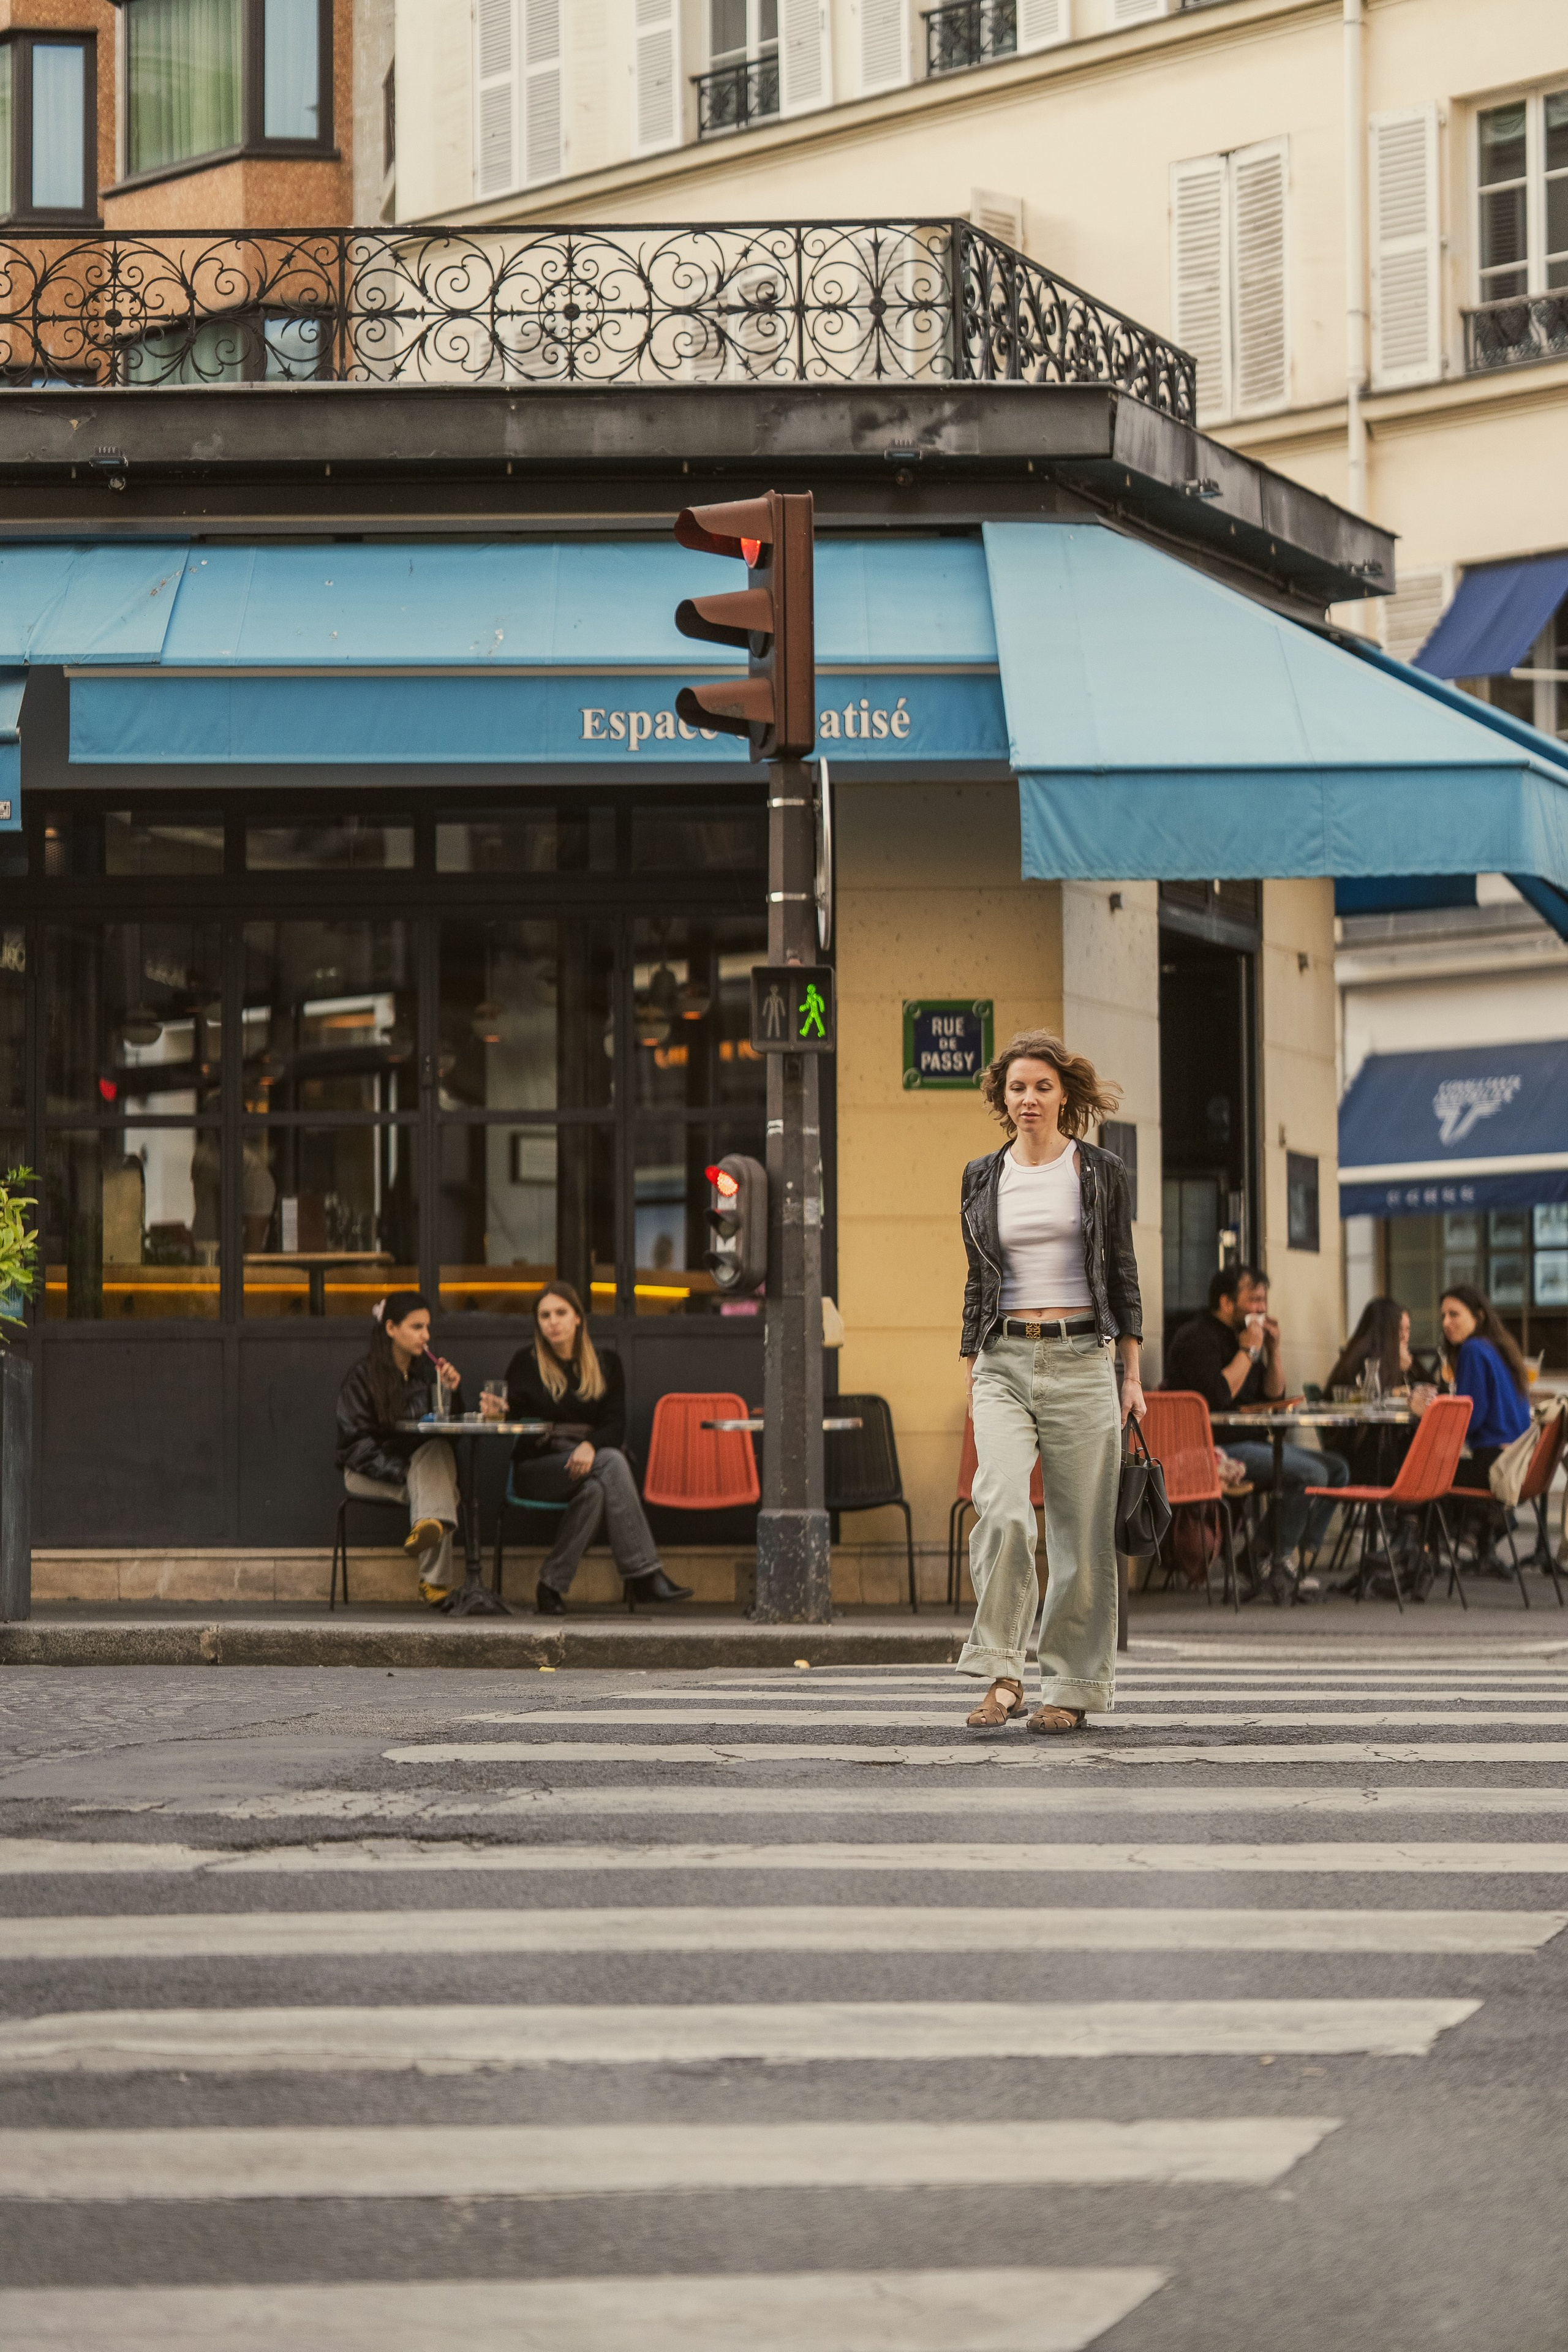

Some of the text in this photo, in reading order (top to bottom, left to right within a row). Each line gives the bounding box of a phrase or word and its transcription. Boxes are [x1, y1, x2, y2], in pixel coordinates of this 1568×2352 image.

[932, 1016, 965, 1036] RUE
[939, 1037, 957, 1050] DE
[921, 1051, 974, 1071] PASSY
